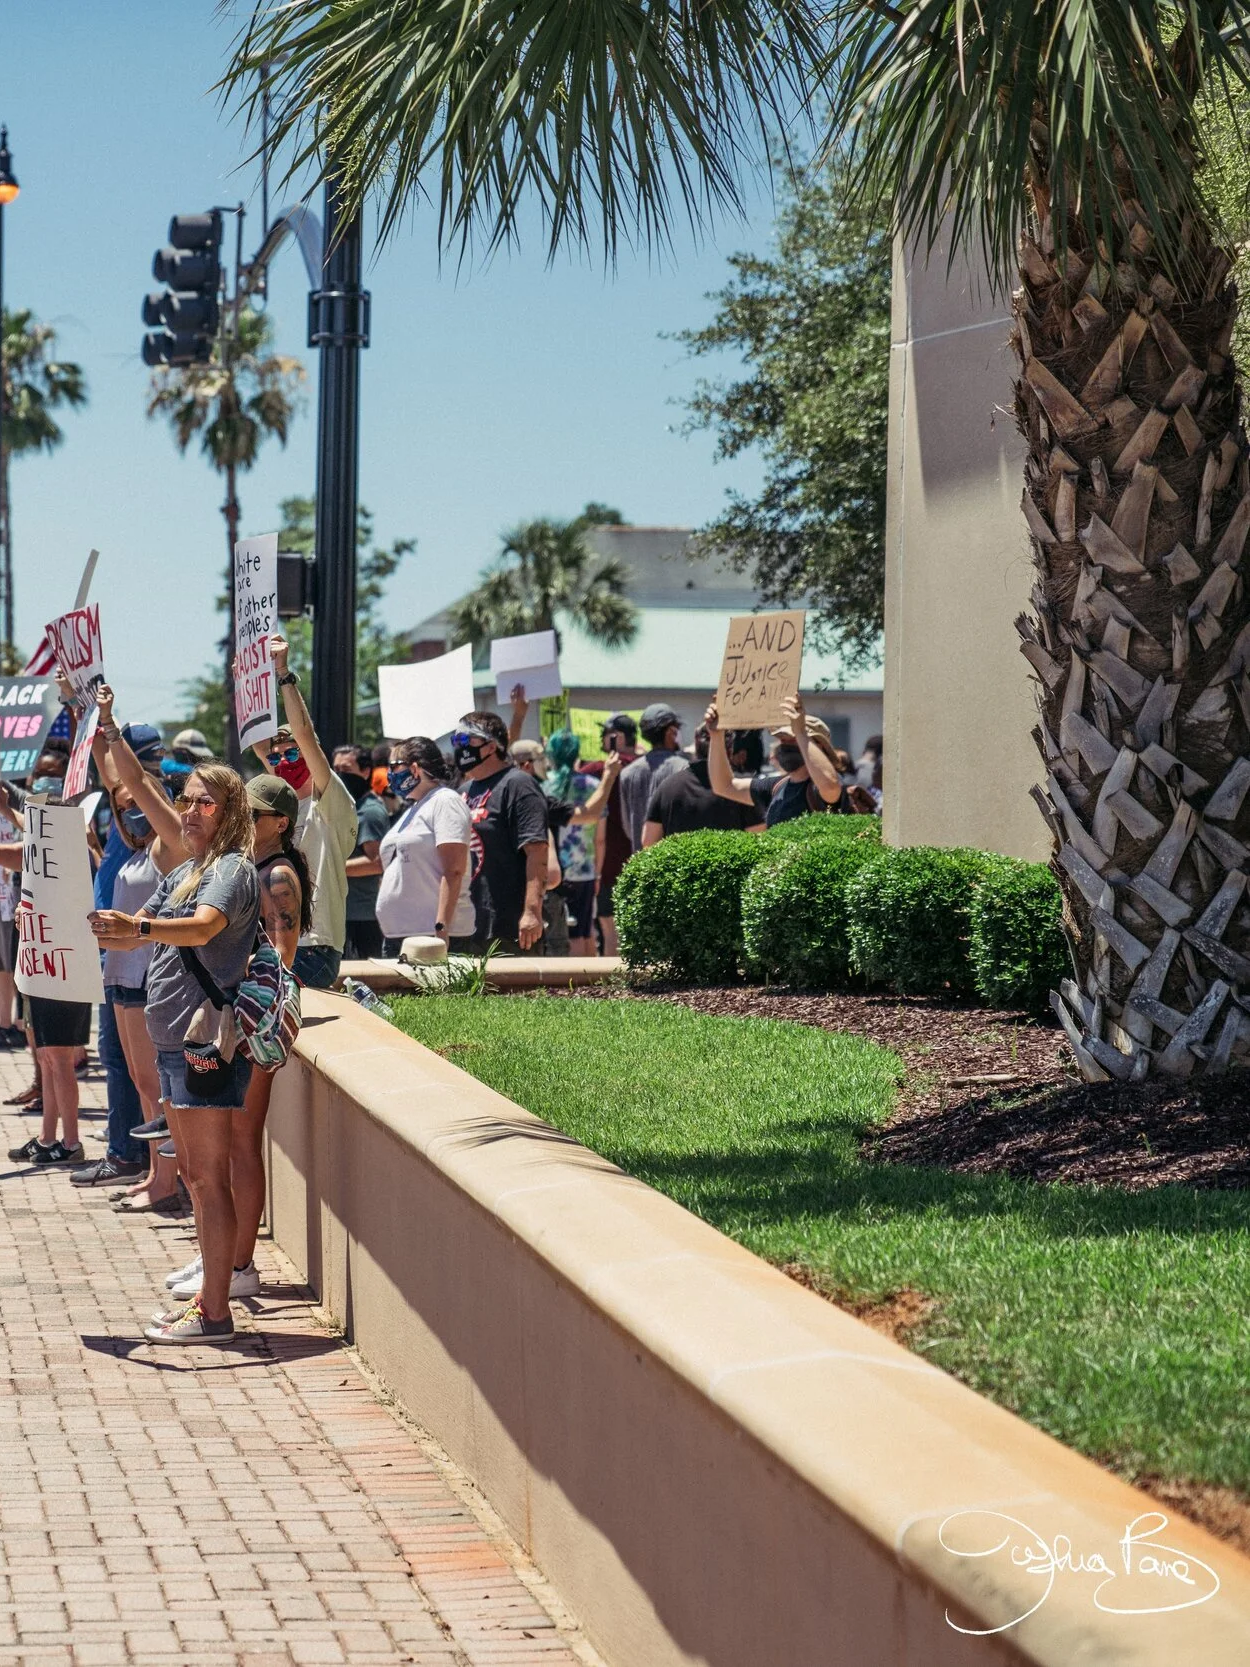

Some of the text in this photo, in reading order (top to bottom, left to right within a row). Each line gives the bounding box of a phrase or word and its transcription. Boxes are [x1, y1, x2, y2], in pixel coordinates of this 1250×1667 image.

[245, 592, 276, 617] other
[45, 602, 103, 676] RACISM
[235, 635, 269, 680] RACIST
[23, 804, 55, 838] TE
